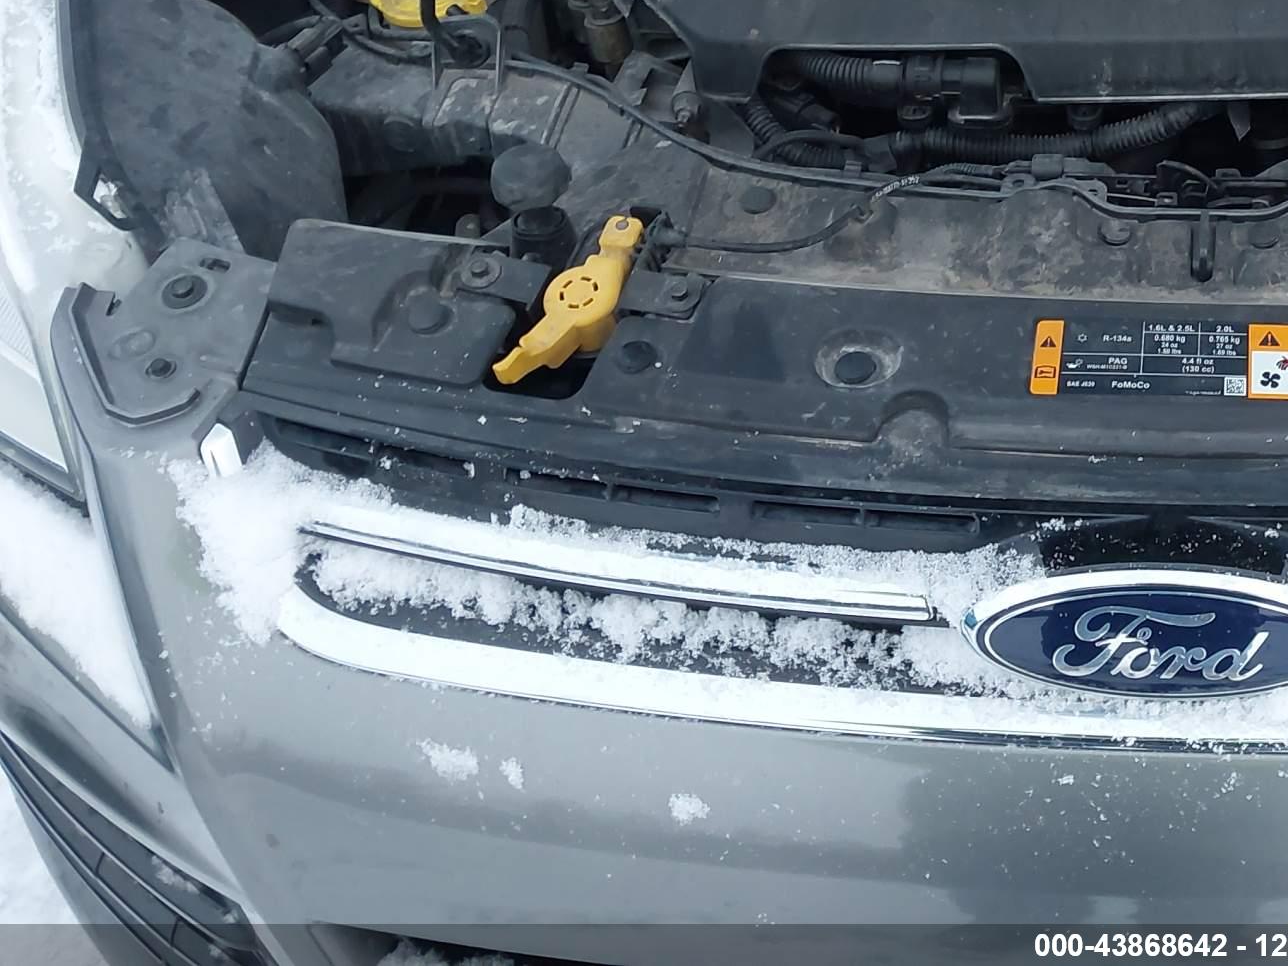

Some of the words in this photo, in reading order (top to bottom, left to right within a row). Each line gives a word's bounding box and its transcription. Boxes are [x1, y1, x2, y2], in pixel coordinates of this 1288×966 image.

[1102, 334, 1132, 342] R-134a
[1176, 335, 1186, 343] kg
[1230, 336, 1240, 344] kg
[1108, 357, 1128, 365] PAG
[1201, 366, 1215, 374] cc)
[1111, 380, 1150, 389] FoMoCo
[1052, 605, 1270, 682] Ford
